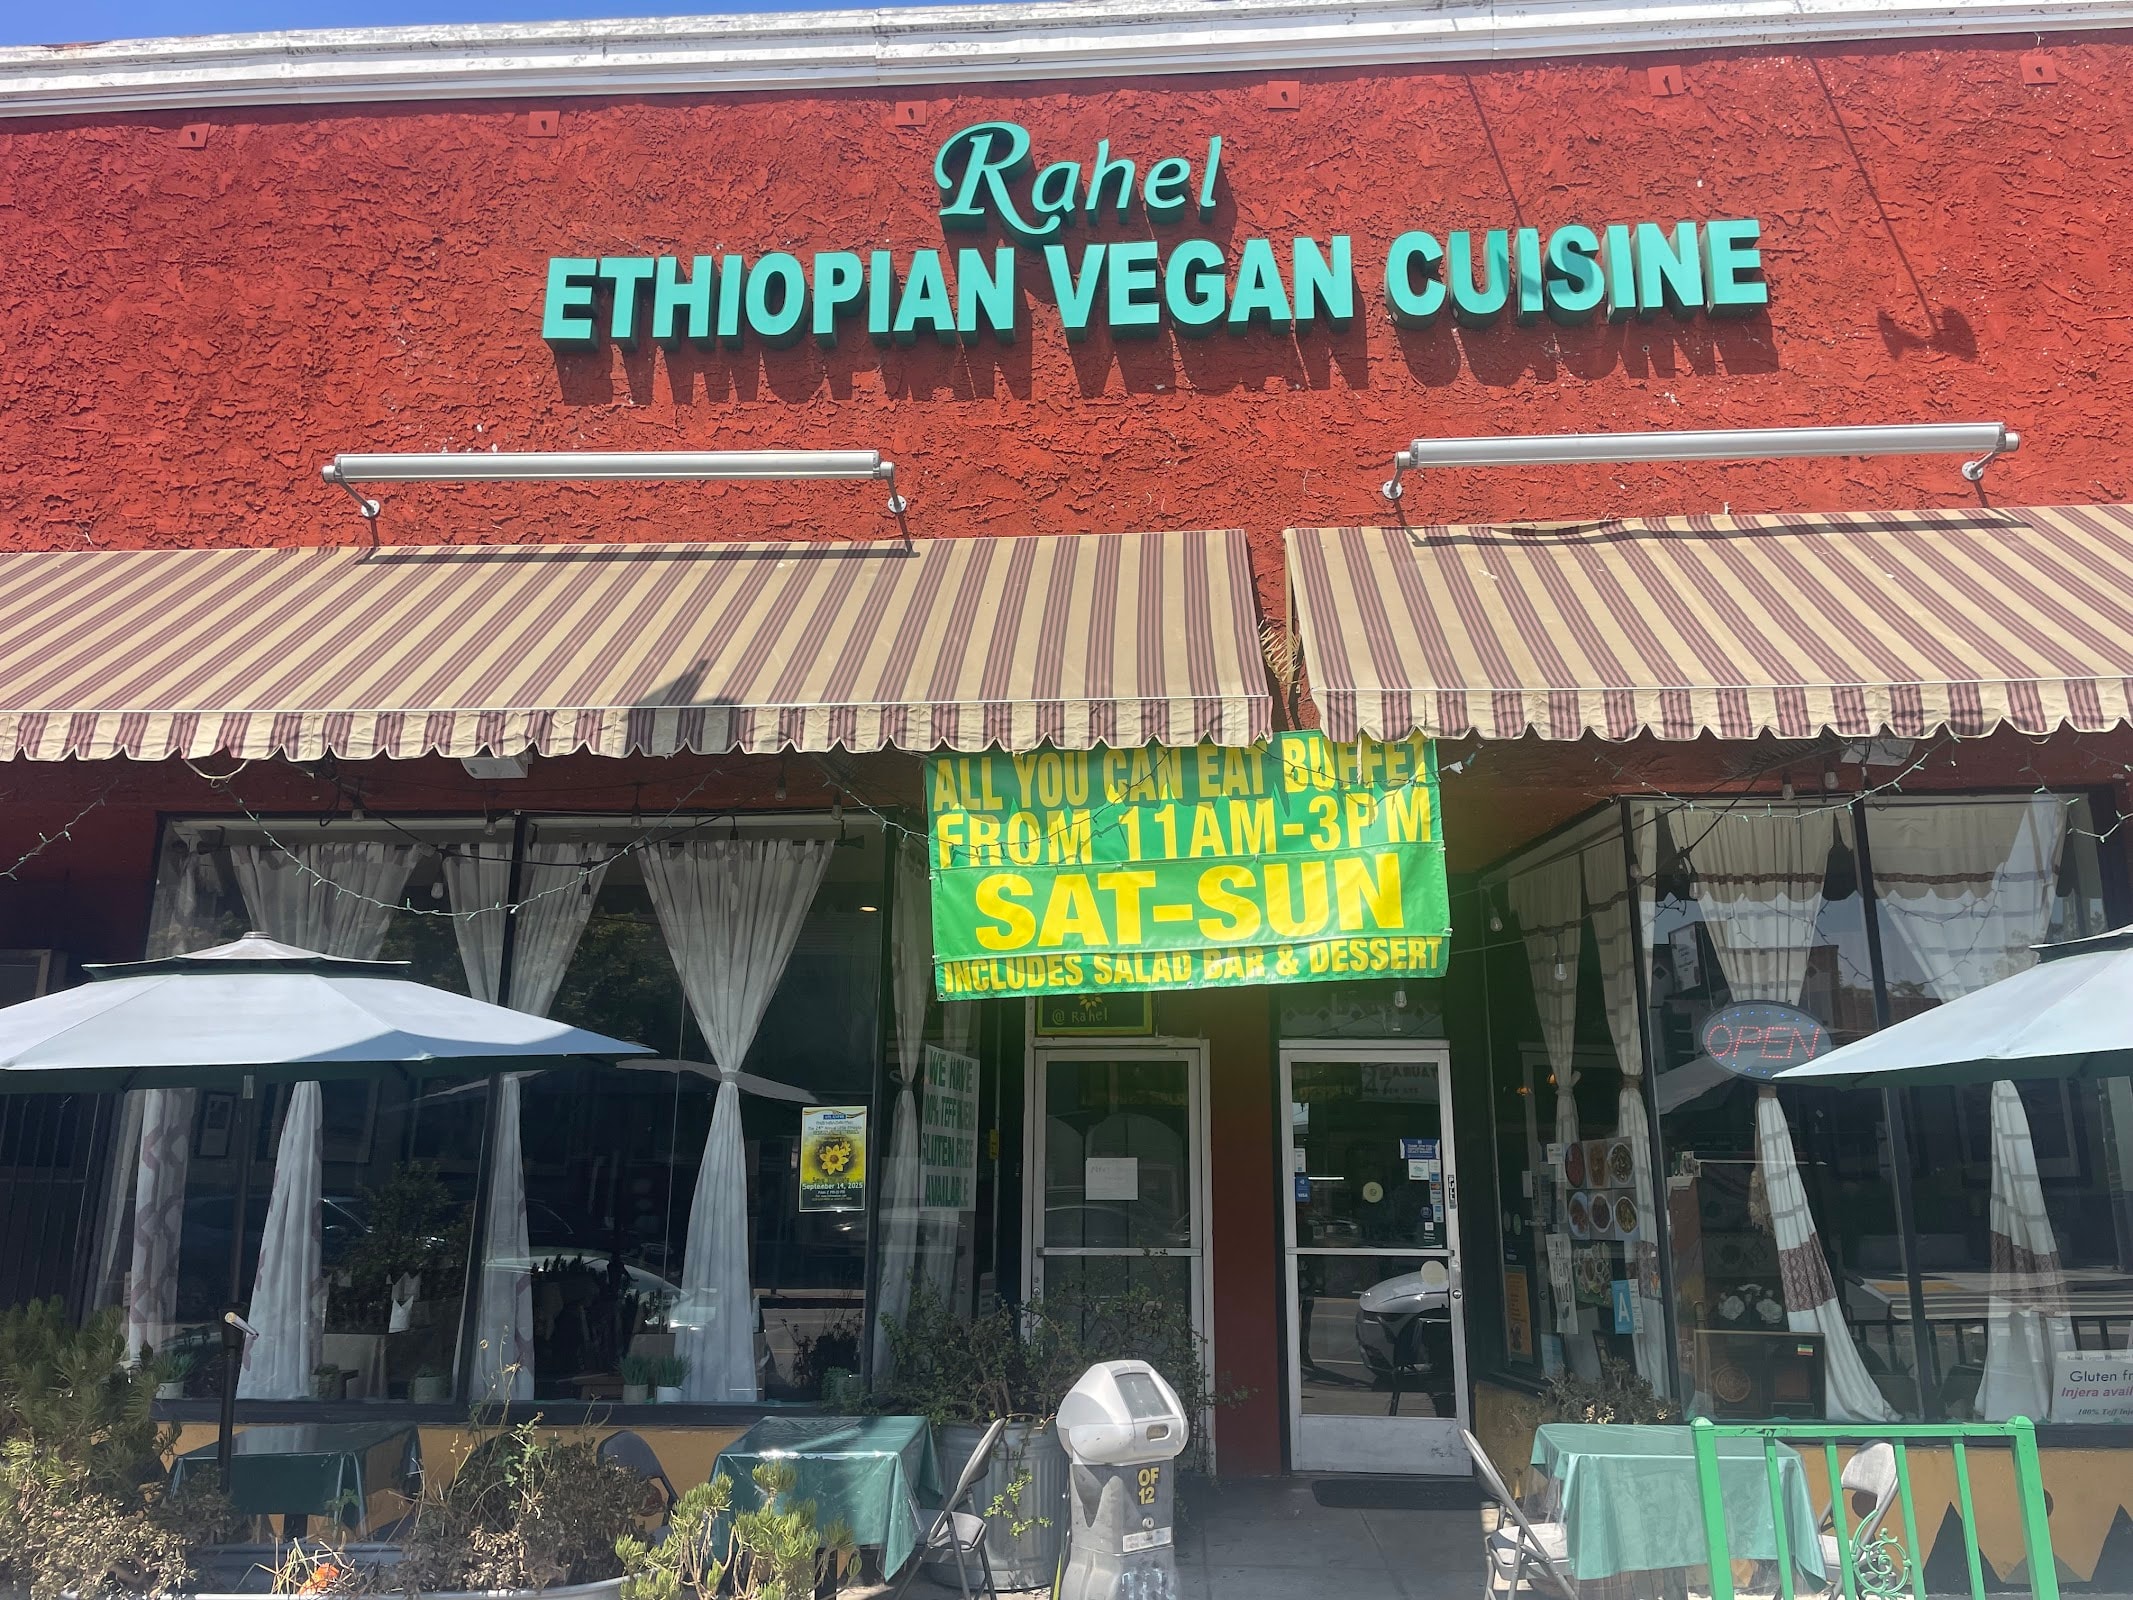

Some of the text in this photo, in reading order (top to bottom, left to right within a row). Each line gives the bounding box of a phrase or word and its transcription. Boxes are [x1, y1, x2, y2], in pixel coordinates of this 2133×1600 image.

[933, 120, 1223, 236] Rahel
[542, 219, 1768, 339] ETHIOPIAN VEGAN CUISINE
[933, 732, 1428, 812] ALL YOU CAN EAT BUFFET
[936, 808, 1093, 869] FROM
[975, 852, 1404, 950] SAT-SUN
[944, 937, 1442, 993] INCLUDES SALAD BAR & DESSERT
[1072, 1007, 1108, 1022] Rahel
[1706, 1025, 1820, 1059] OPEN
[929, 1051, 973, 1093] WE HAVE
[802, 1183, 834, 1191] September
[925, 1175, 969, 1207] AVAILABLE
[1618, 1292, 1631, 1322] A
[2069, 1370, 2117, 1382] Gluten
[2061, 1387, 2099, 1399] Injera
[1138, 1467, 1159, 1486] OF
[1139, 1487, 1155, 1505] 12
